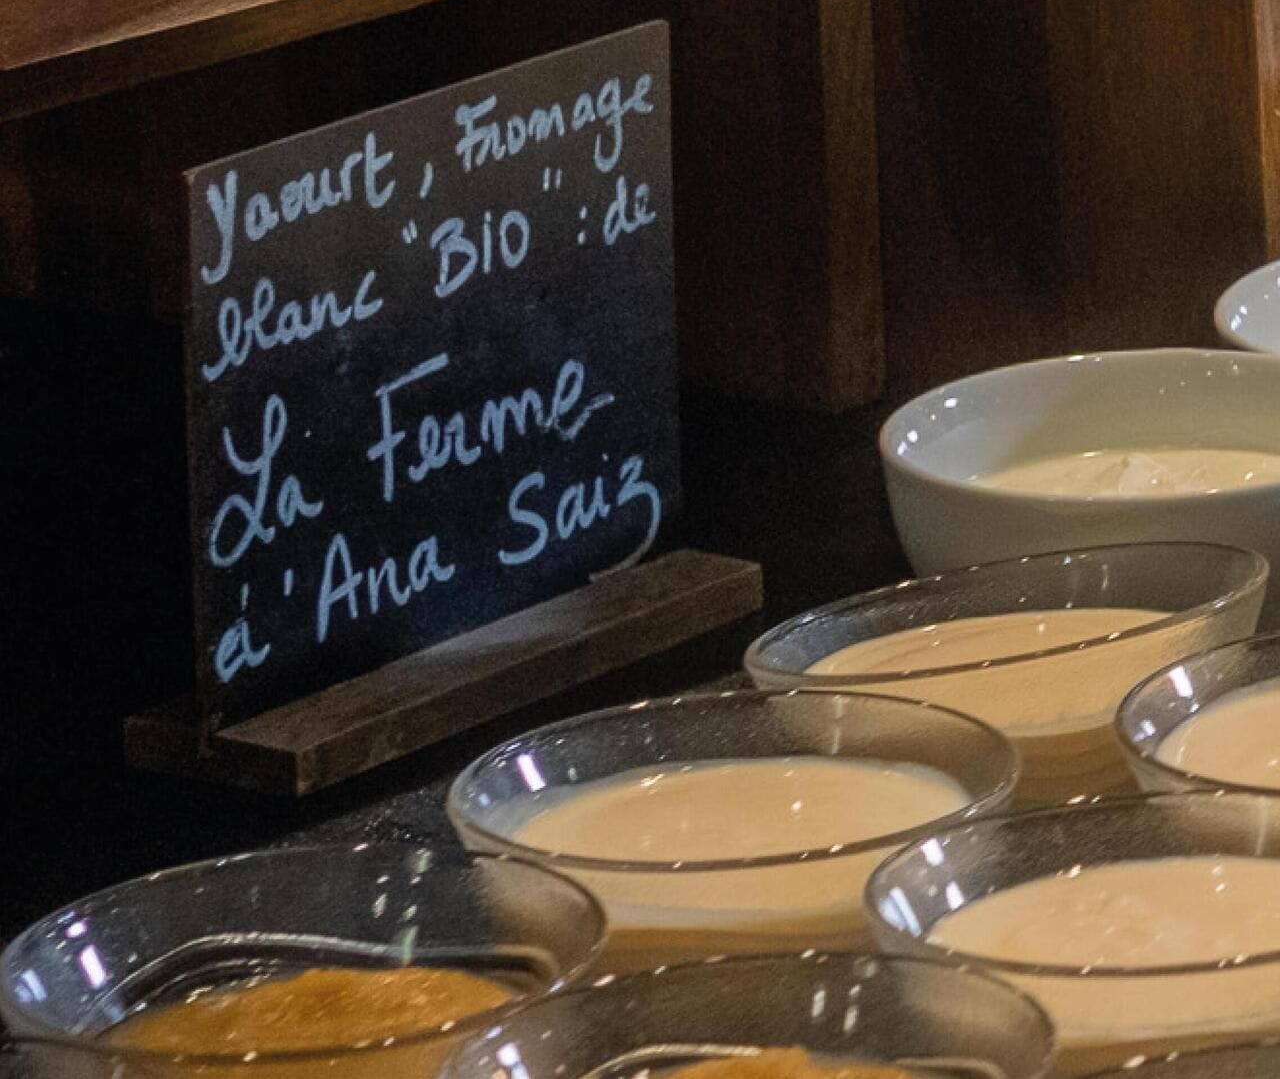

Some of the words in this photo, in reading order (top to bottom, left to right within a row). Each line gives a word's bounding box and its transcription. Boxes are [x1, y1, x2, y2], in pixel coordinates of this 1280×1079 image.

[454, 72, 654, 172] Fromage
[202, 270, 384, 382] blanc
[209, 393, 323, 568] La
